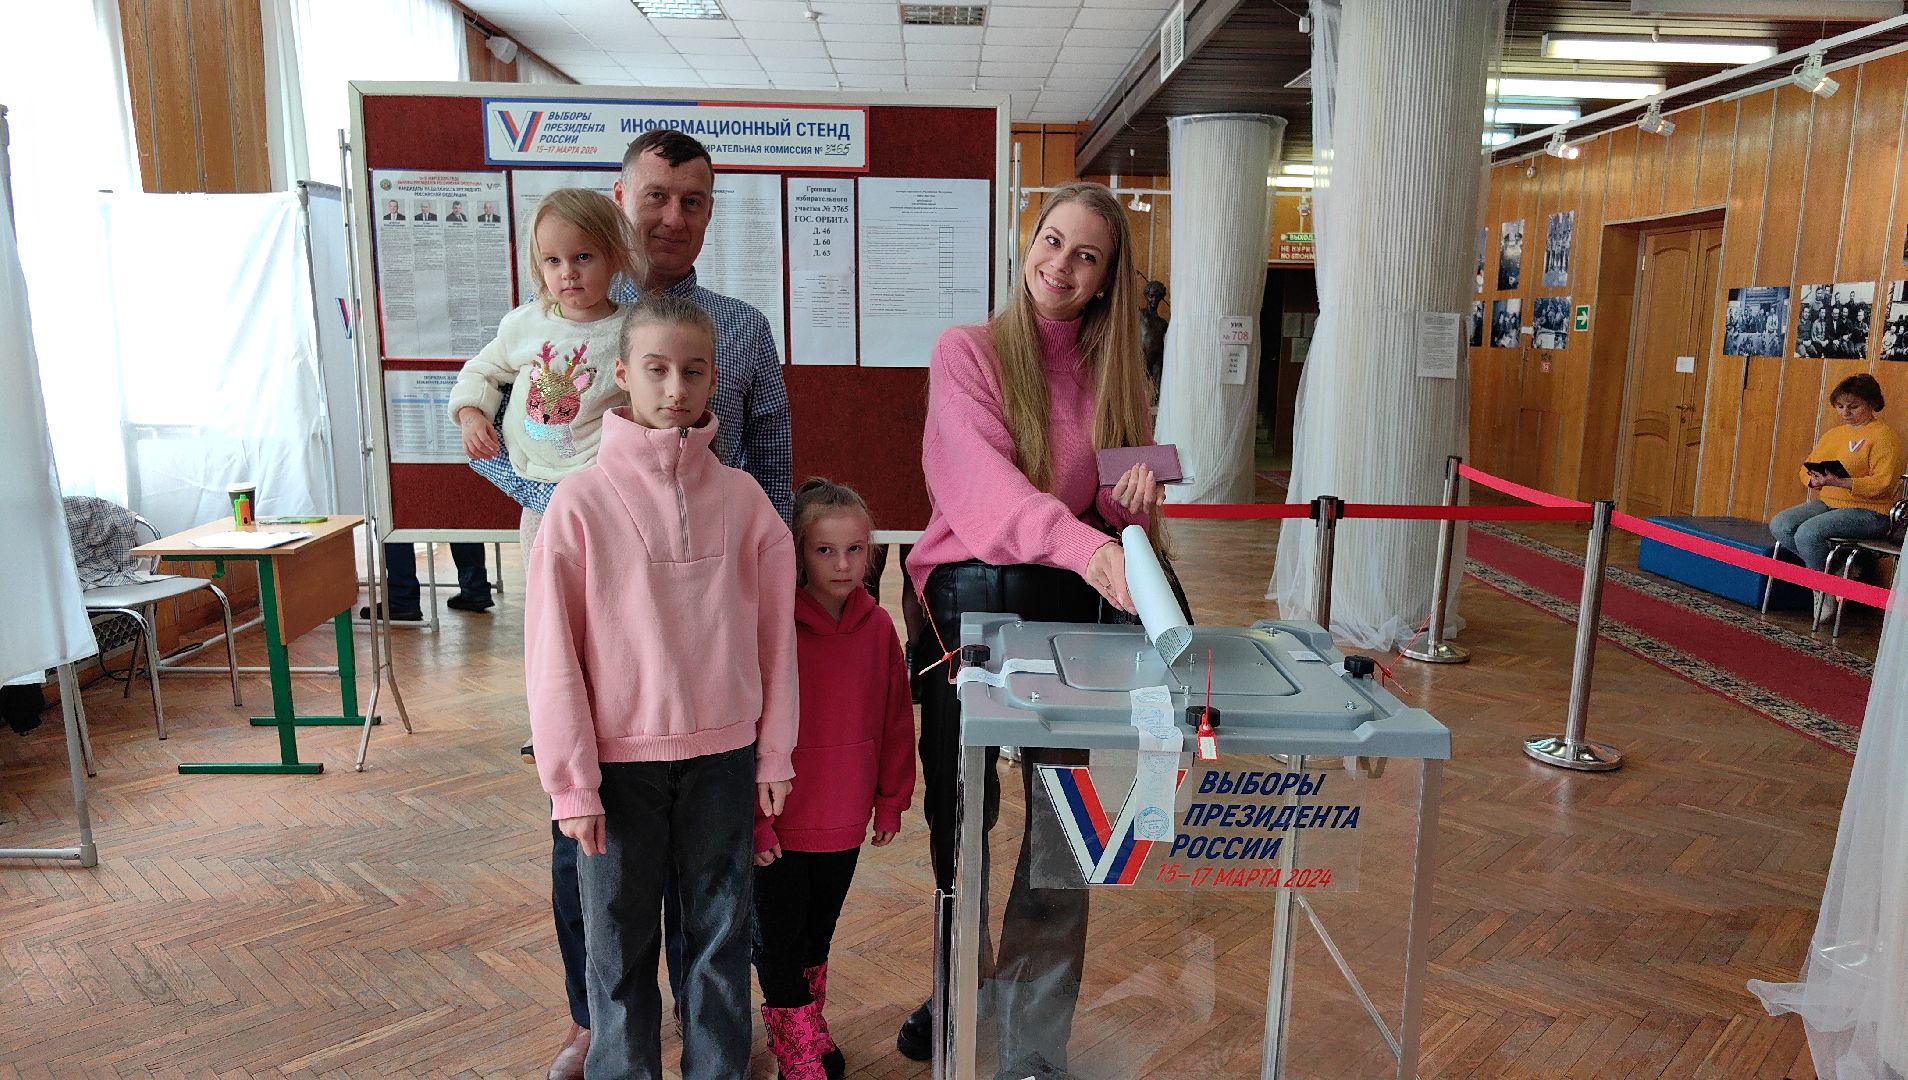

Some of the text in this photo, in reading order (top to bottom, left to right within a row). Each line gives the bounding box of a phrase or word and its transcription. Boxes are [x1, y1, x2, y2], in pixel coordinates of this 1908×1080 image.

[548, 111, 592, 121] ВЫБОРЫ
[543, 123, 606, 133] ПРЕЗИДЕНТА
[620, 118, 851, 140] ИНФОРМАЦИОННЫЙ СТЕНД
[539, 135, 579, 144] РОССИИ
[556, 146, 580, 154] МАРТА
[580, 146, 598, 154] 2024
[703, 144, 762, 154] ИРАТЕЛЬНАЯ
[764, 145, 812, 154] КОМИССИЯ
[814, 146, 823, 154] №
[796, 195, 848, 203] избирательного
[832, 205, 849, 213] 3765
[815, 216, 849, 224] ОРБИТА
[822, 227, 831, 235] 46
[1232, 331, 1249, 341] 708
[1198, 770, 1327, 796] ВЫБОРЫ
[1182, 803, 1361, 832] ПРЕЗИДЕНТА
[1168, 835, 1284, 860] РОССИИ
[1212, 866, 1281, 888] МАРТА
[1283, 867, 1332, 888] 2024
